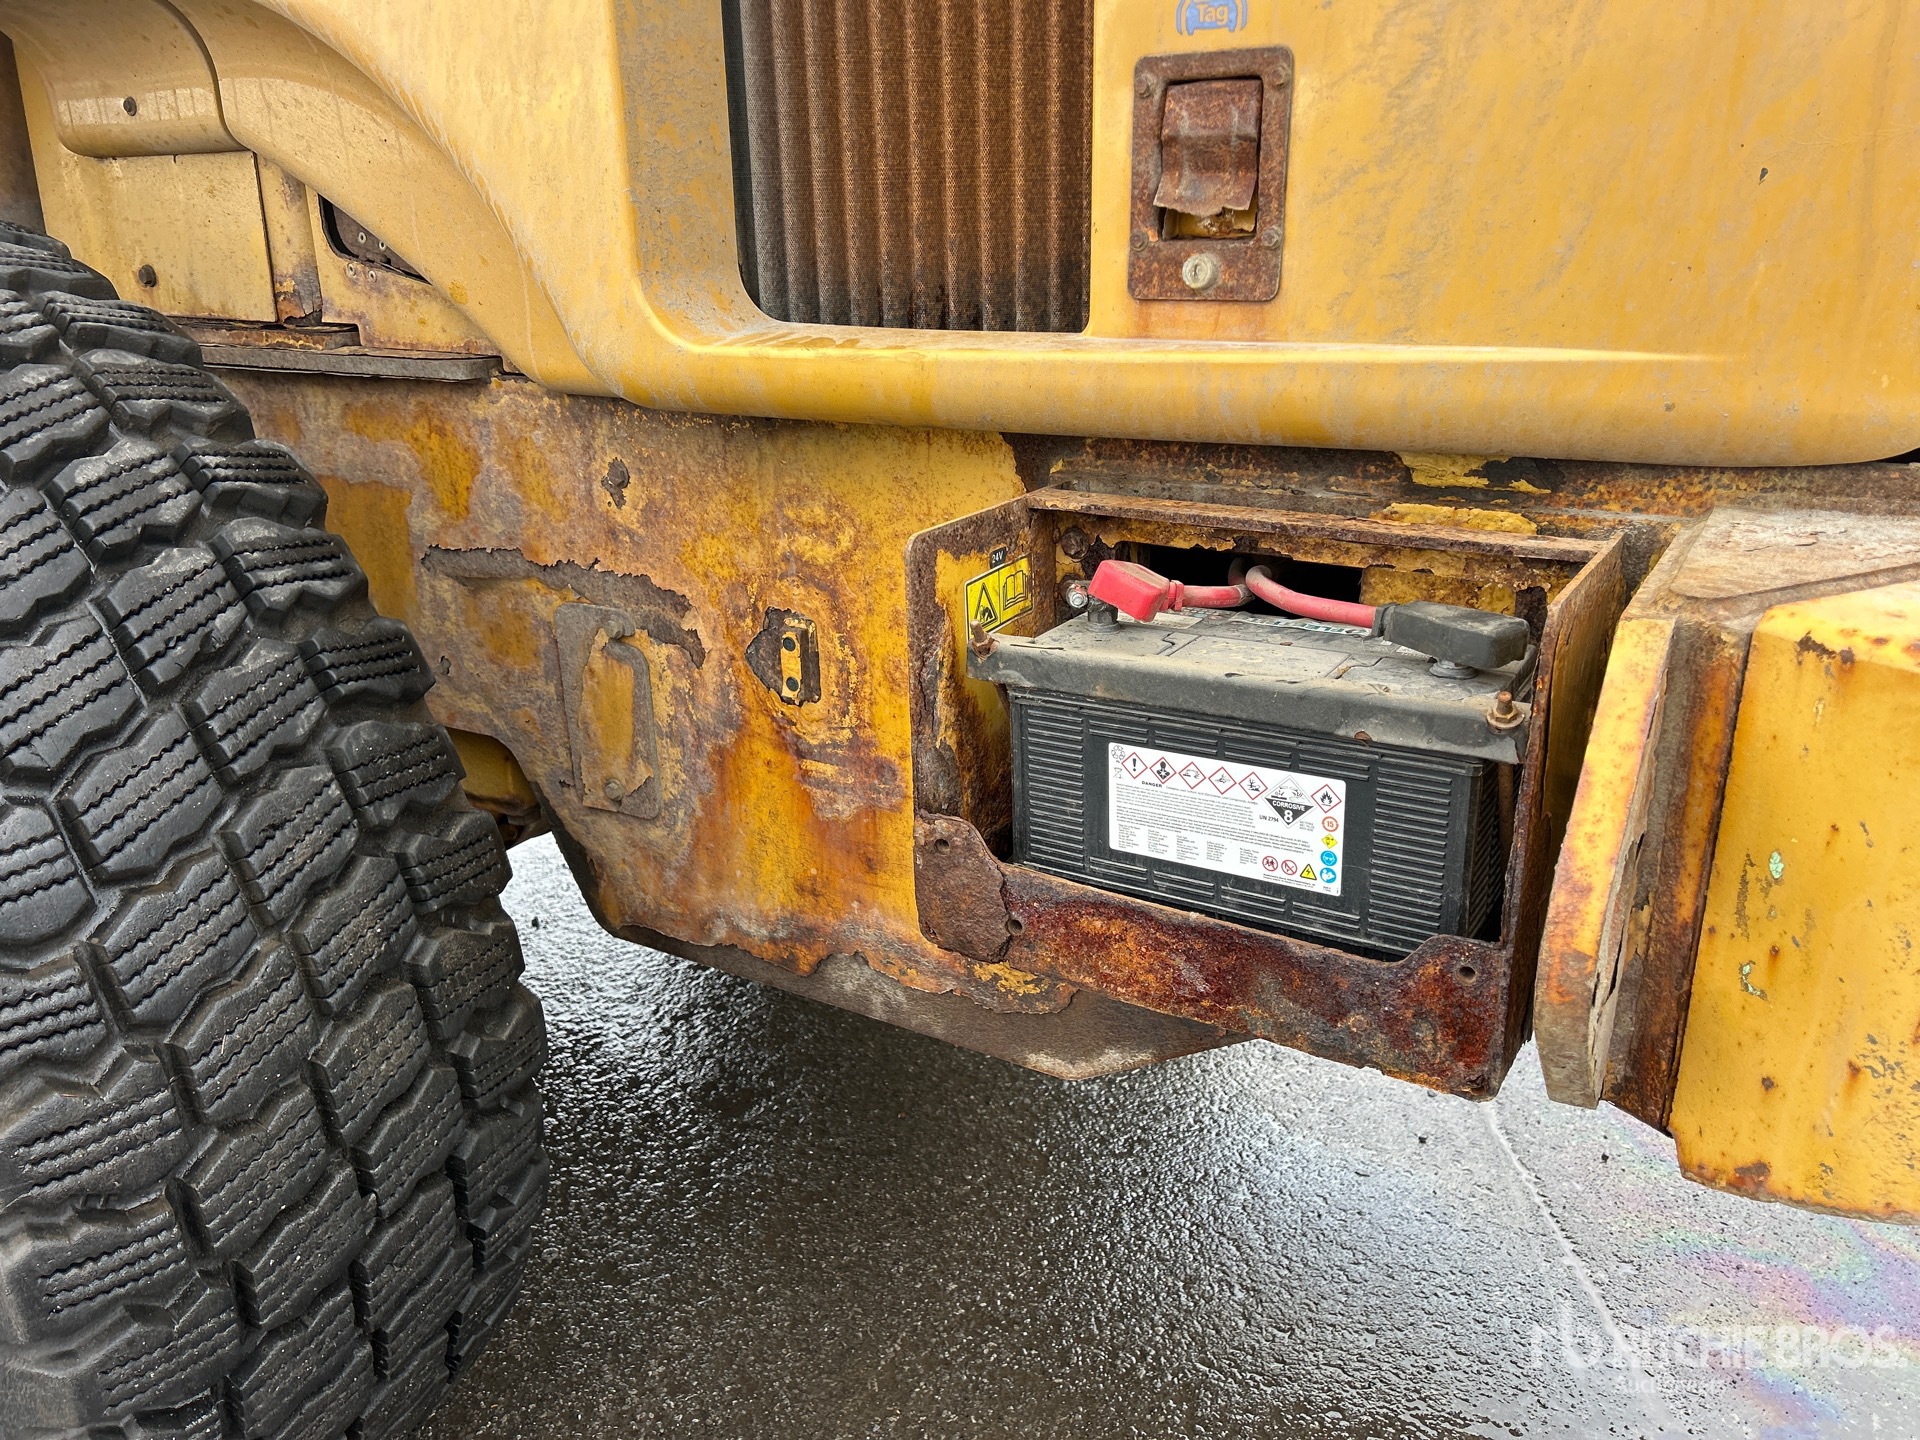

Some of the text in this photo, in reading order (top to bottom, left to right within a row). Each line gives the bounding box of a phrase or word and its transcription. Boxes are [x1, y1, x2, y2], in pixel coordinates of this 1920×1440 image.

[1196, 3, 1229, 25] Tag
[991, 550, 1004, 563] 24V
[1141, 780, 1163, 788] DANGER
[1272, 800, 1306, 812] CORROSIVE
[1283, 809, 1293, 823] 8
